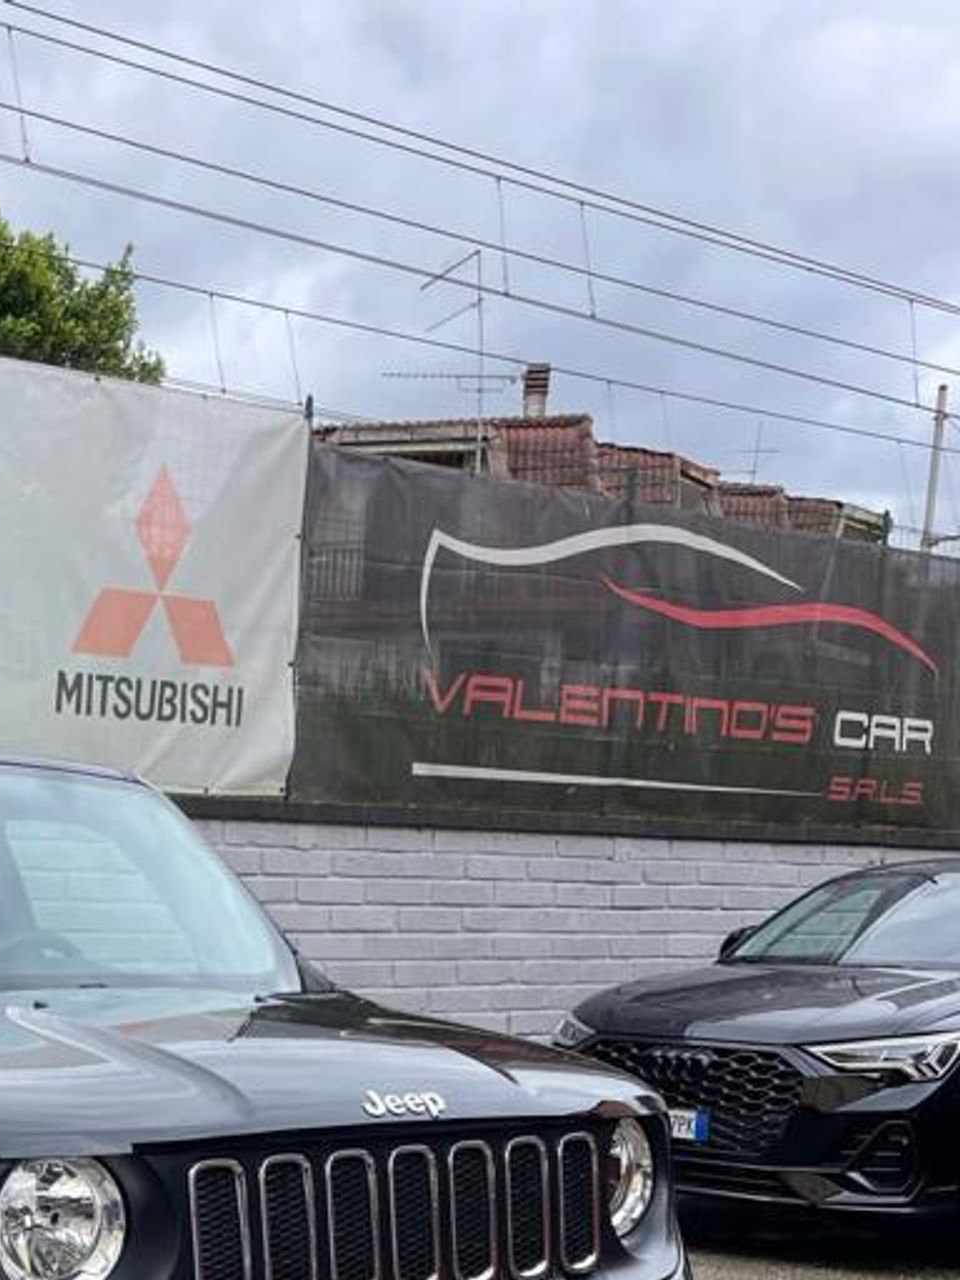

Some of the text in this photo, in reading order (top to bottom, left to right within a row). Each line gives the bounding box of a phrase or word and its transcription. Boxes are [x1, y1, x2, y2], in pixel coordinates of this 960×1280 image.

[55, 670, 244, 728] MITSUBISHI
[834, 710, 934, 755] CAR
[362, 1089, 446, 1119] Jeep
